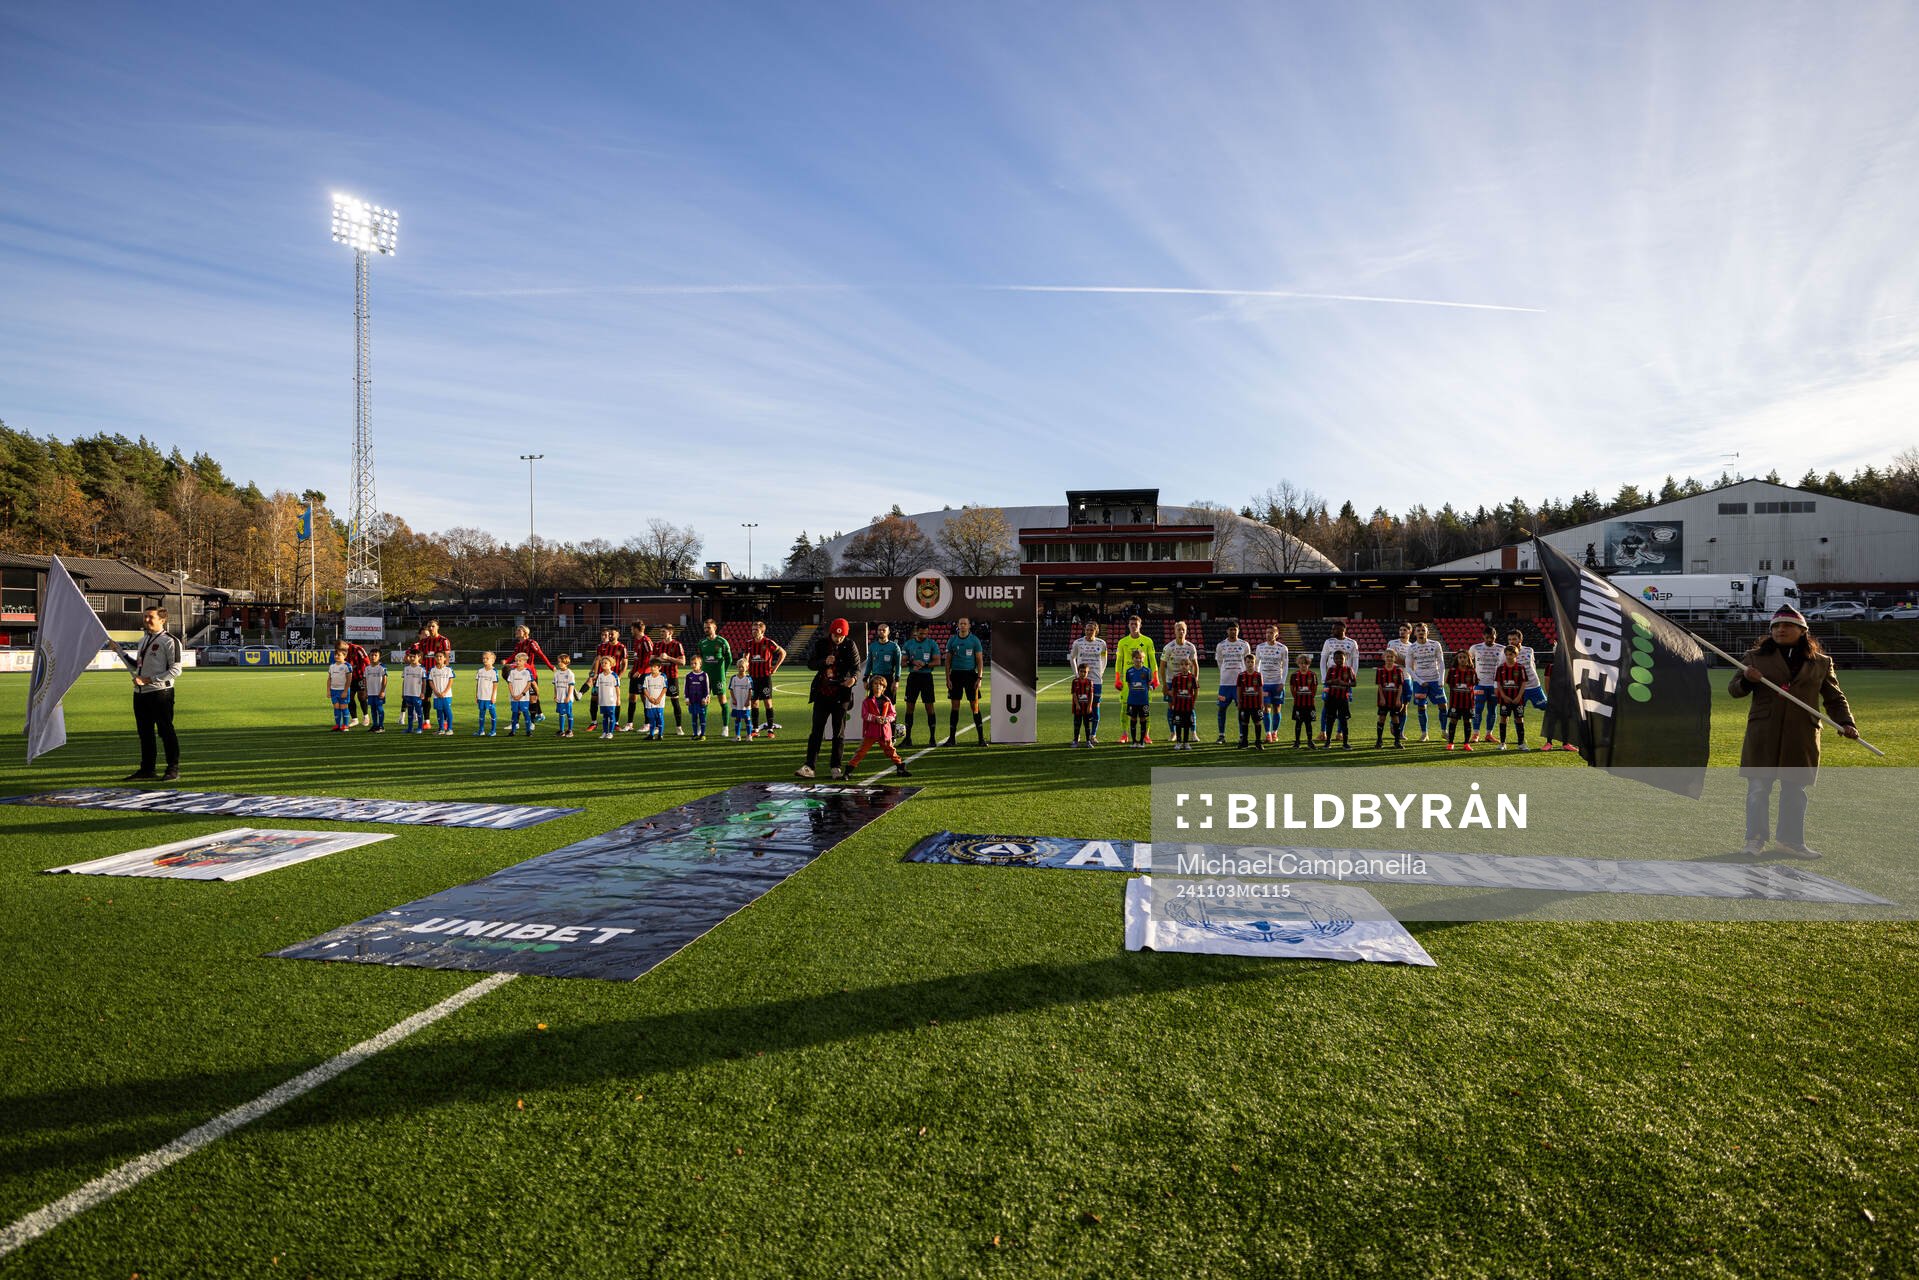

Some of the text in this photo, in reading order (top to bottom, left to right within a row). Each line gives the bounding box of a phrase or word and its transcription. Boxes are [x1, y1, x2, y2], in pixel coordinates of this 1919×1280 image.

[834, 586, 892, 600] UNIBET
[965, 585, 1025, 600] UNIBET
[290, 630, 301, 640] BP
[269, 650, 331, 665] MULTISPRAY
[409, 917, 636, 944] UNIBET
